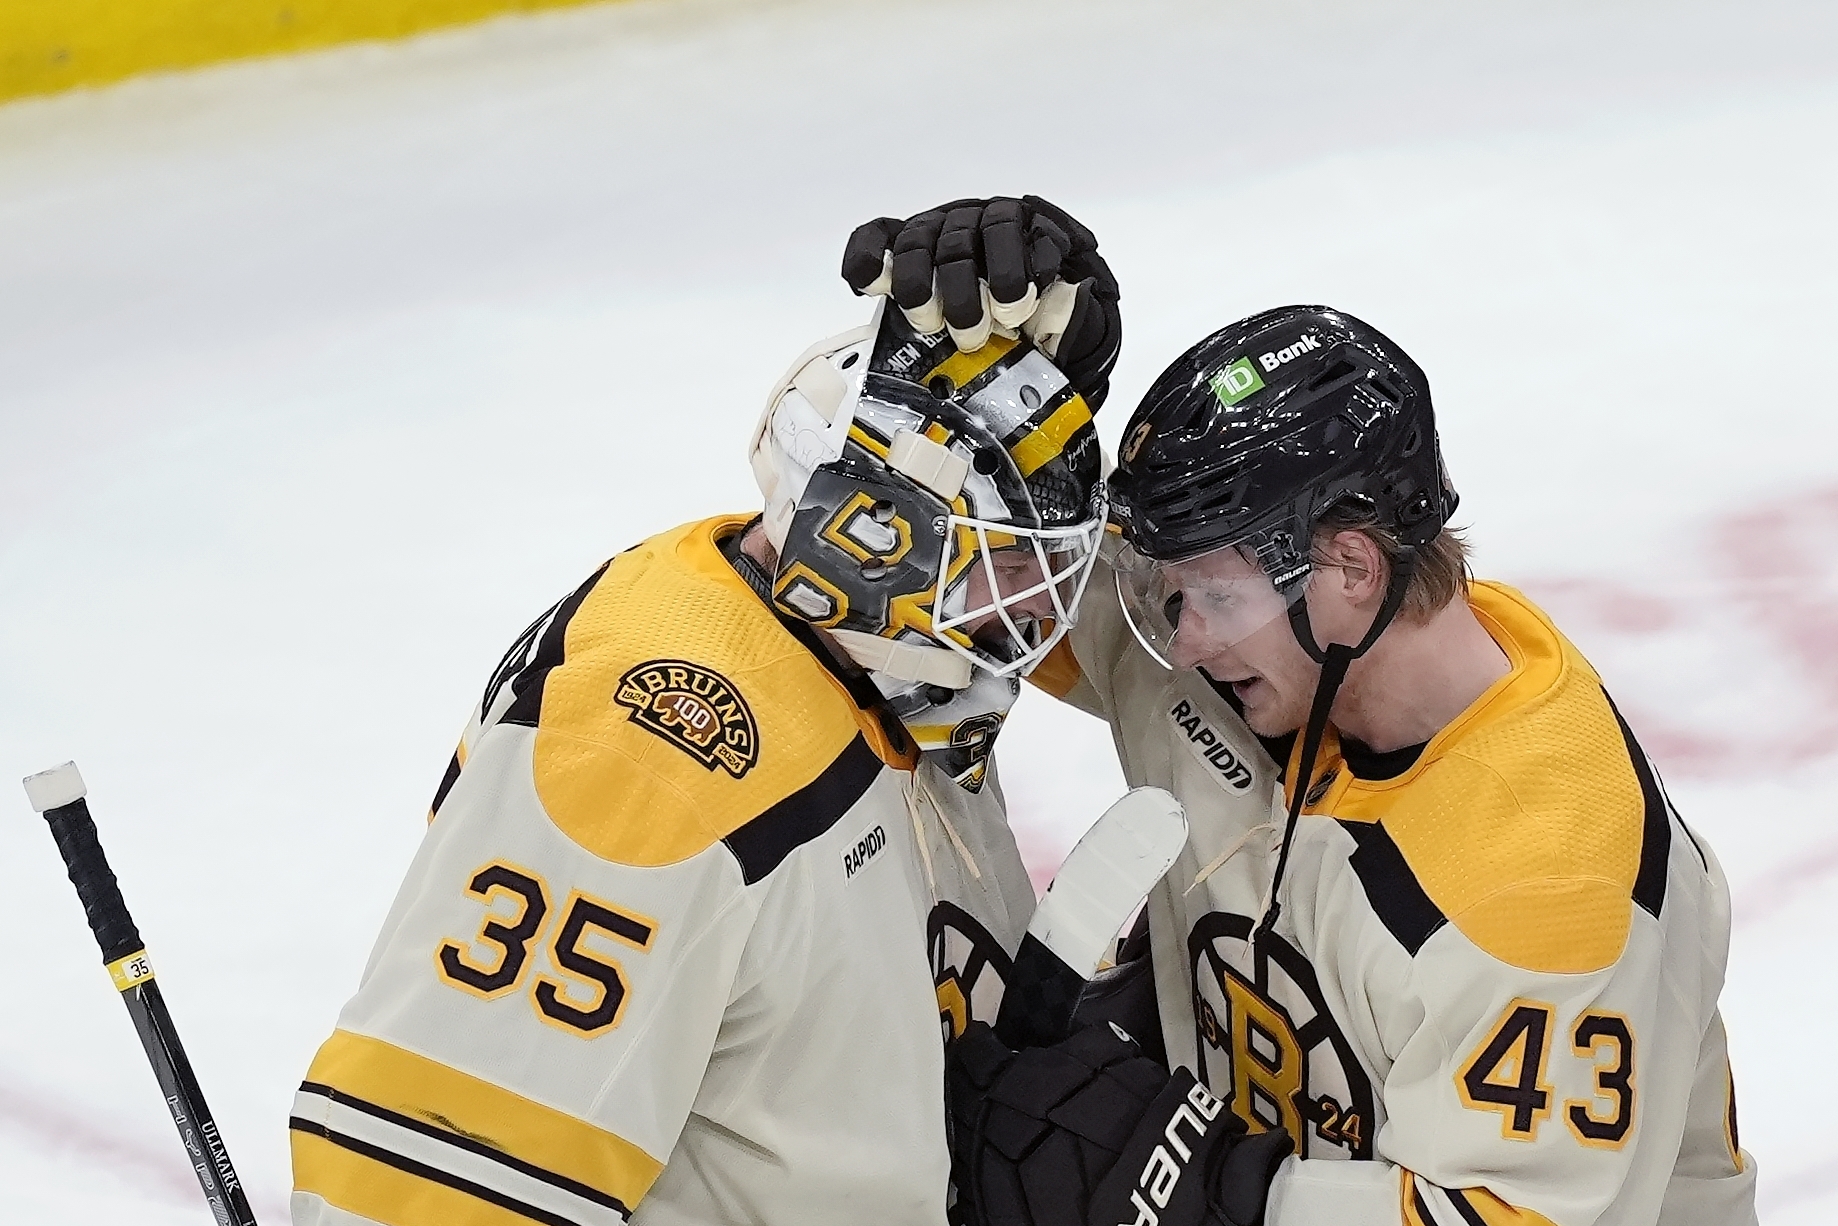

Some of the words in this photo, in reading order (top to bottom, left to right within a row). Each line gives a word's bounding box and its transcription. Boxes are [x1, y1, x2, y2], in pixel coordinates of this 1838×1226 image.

[1258, 334, 1322, 373] Bank
[640, 667, 748, 748] BRUINS
[673, 696, 711, 730] 100
[129, 960, 150, 979] 35
[434, 859, 661, 1041] 35
[1223, 968, 1302, 1155] B
[1454, 1000, 1639, 1152] 43
[200, 1120, 242, 1194] ULLMARK
[1320, 1100, 1363, 1151] 24
